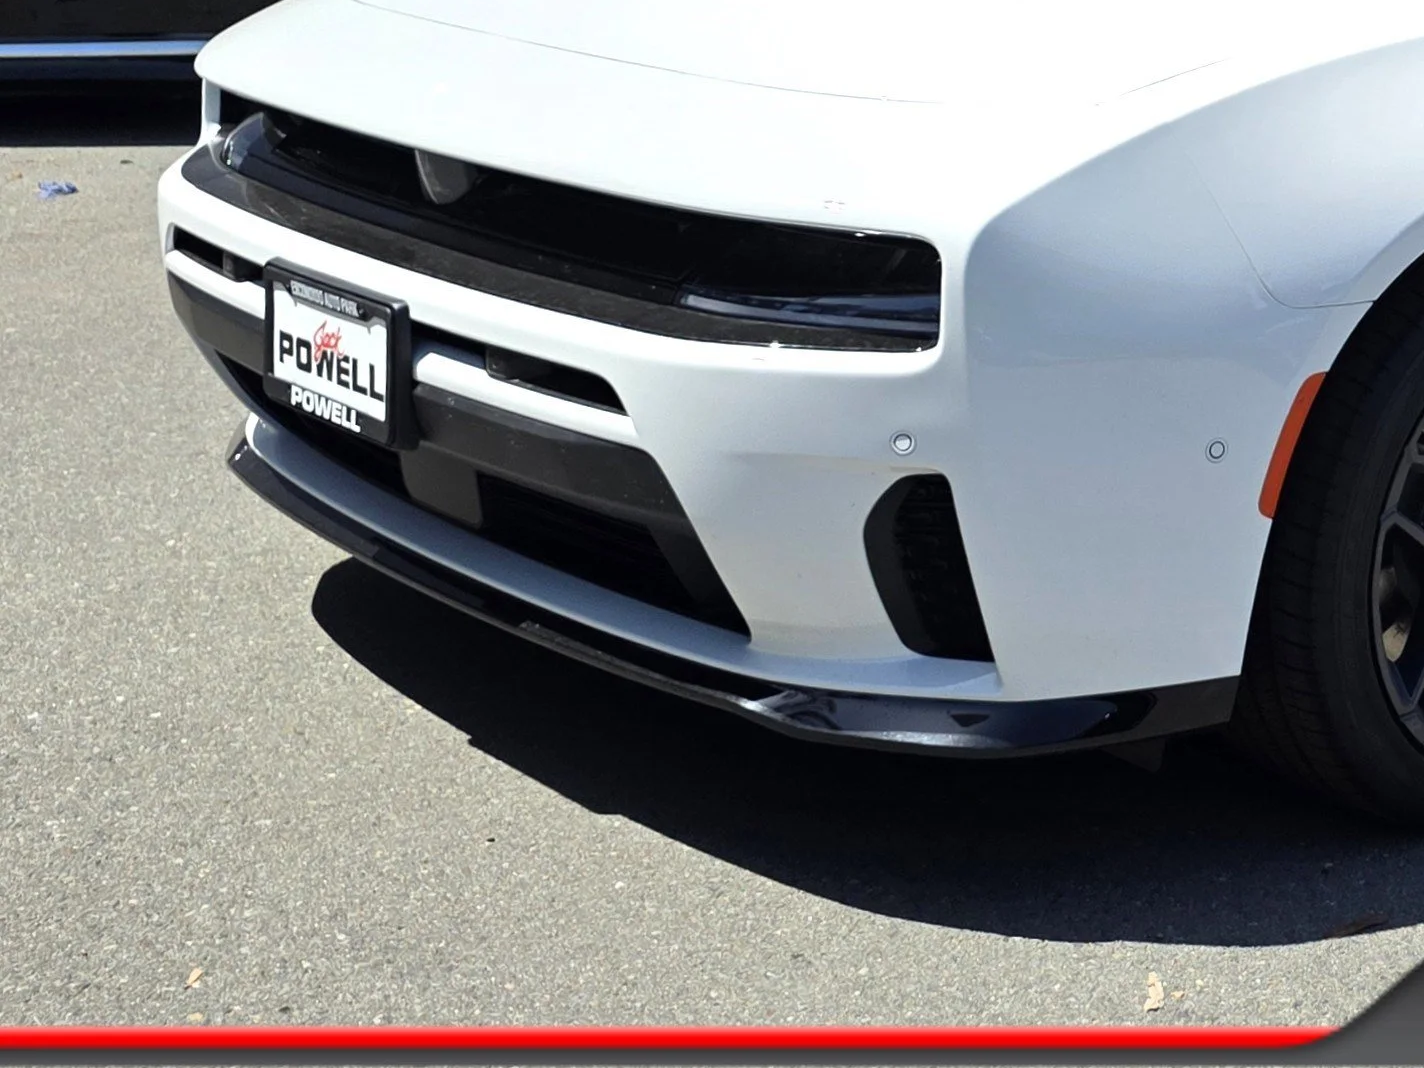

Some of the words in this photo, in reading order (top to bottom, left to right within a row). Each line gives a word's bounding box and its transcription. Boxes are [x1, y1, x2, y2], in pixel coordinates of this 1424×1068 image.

[279, 329, 385, 403] POWELL
[313, 320, 345, 364] Jack
[290, 384, 362, 433] POWELL
